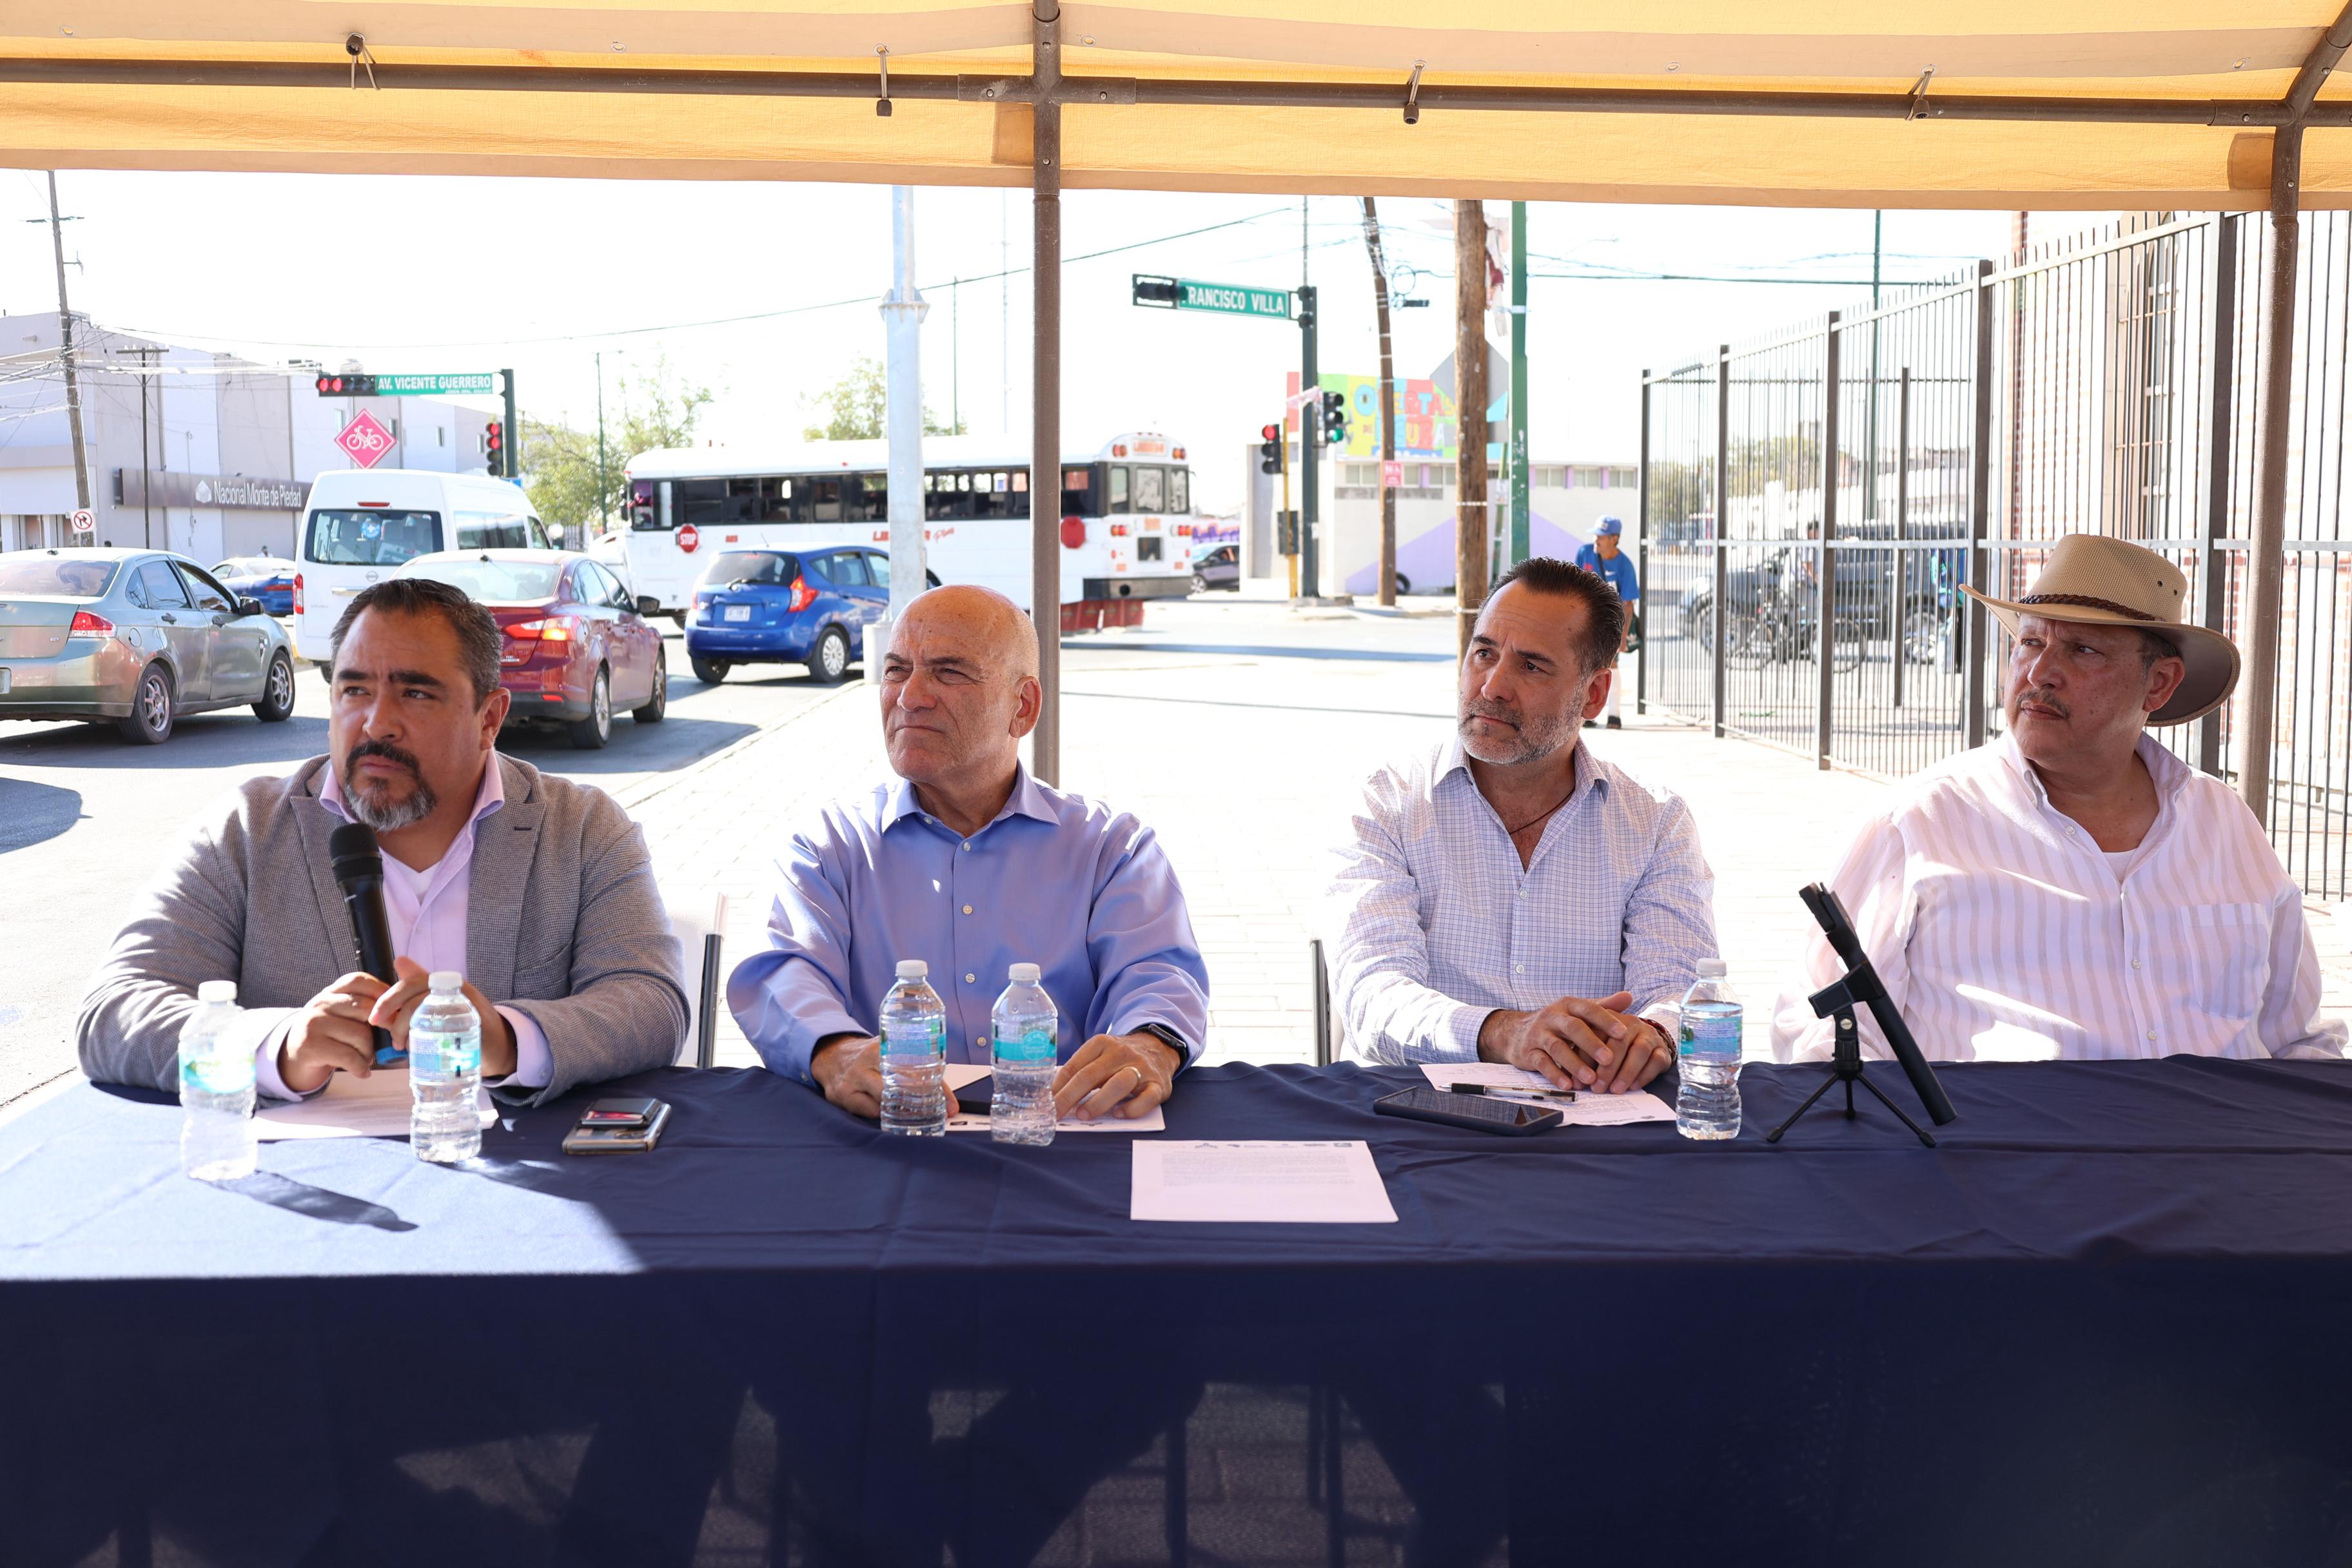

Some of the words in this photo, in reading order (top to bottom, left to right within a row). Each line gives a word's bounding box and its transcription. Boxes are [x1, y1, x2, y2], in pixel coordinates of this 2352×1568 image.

[1251, 293, 1285, 314] VILLA
[378, 377, 392, 390] AV.
[395, 377, 436, 390] VICENTE
[438, 375, 491, 389] GUERRERO
[1354, 384, 1455, 417] OERTAS
[214, 480, 246, 504] Nacional
[247, 482, 269, 506] Monte
[270, 485, 279, 507] de
[279, 484, 302, 507] Piedad
[680, 533, 696, 545] STOP
